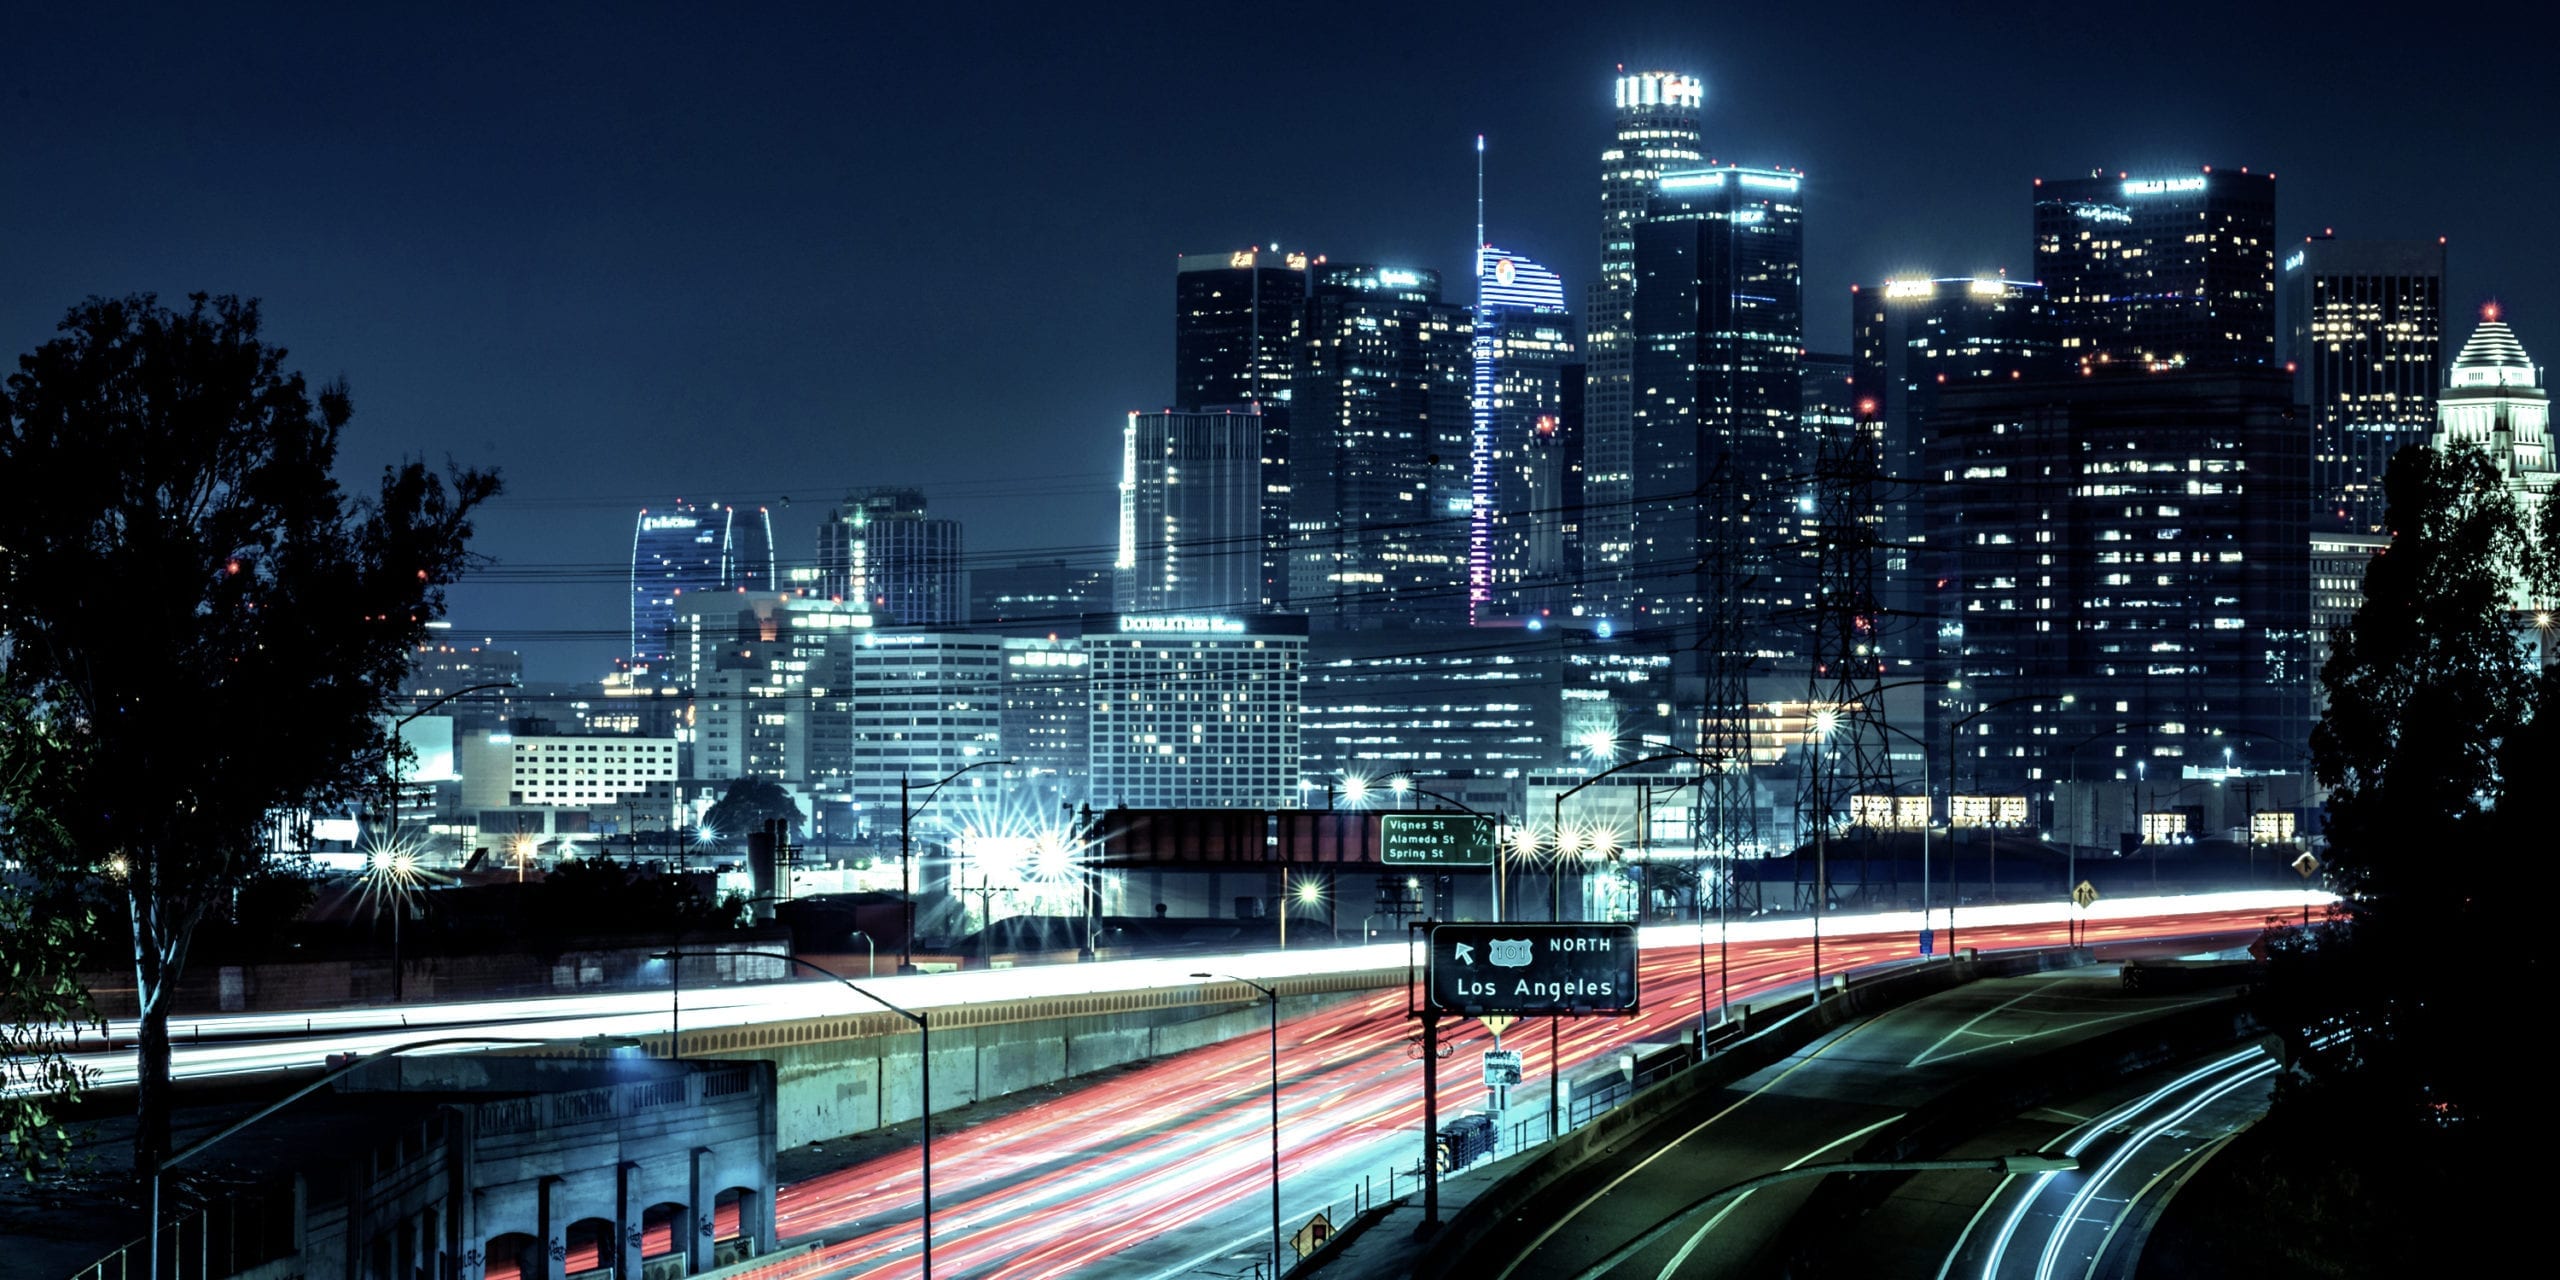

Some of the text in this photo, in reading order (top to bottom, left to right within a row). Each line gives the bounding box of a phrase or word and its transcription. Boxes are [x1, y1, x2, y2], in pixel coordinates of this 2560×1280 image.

[1389, 820, 1427, 832] Vignes
[1432, 820, 1445, 830] St
[1389, 834, 1438, 844] Alameda
[1442, 834, 1455, 844] St
[1389, 848, 1426, 860] Spring
[1431, 848, 1444, 858] St
[1496, 938, 1611, 960] 101 NORTH
[1457, 978, 1613, 1002] Los Angeles
